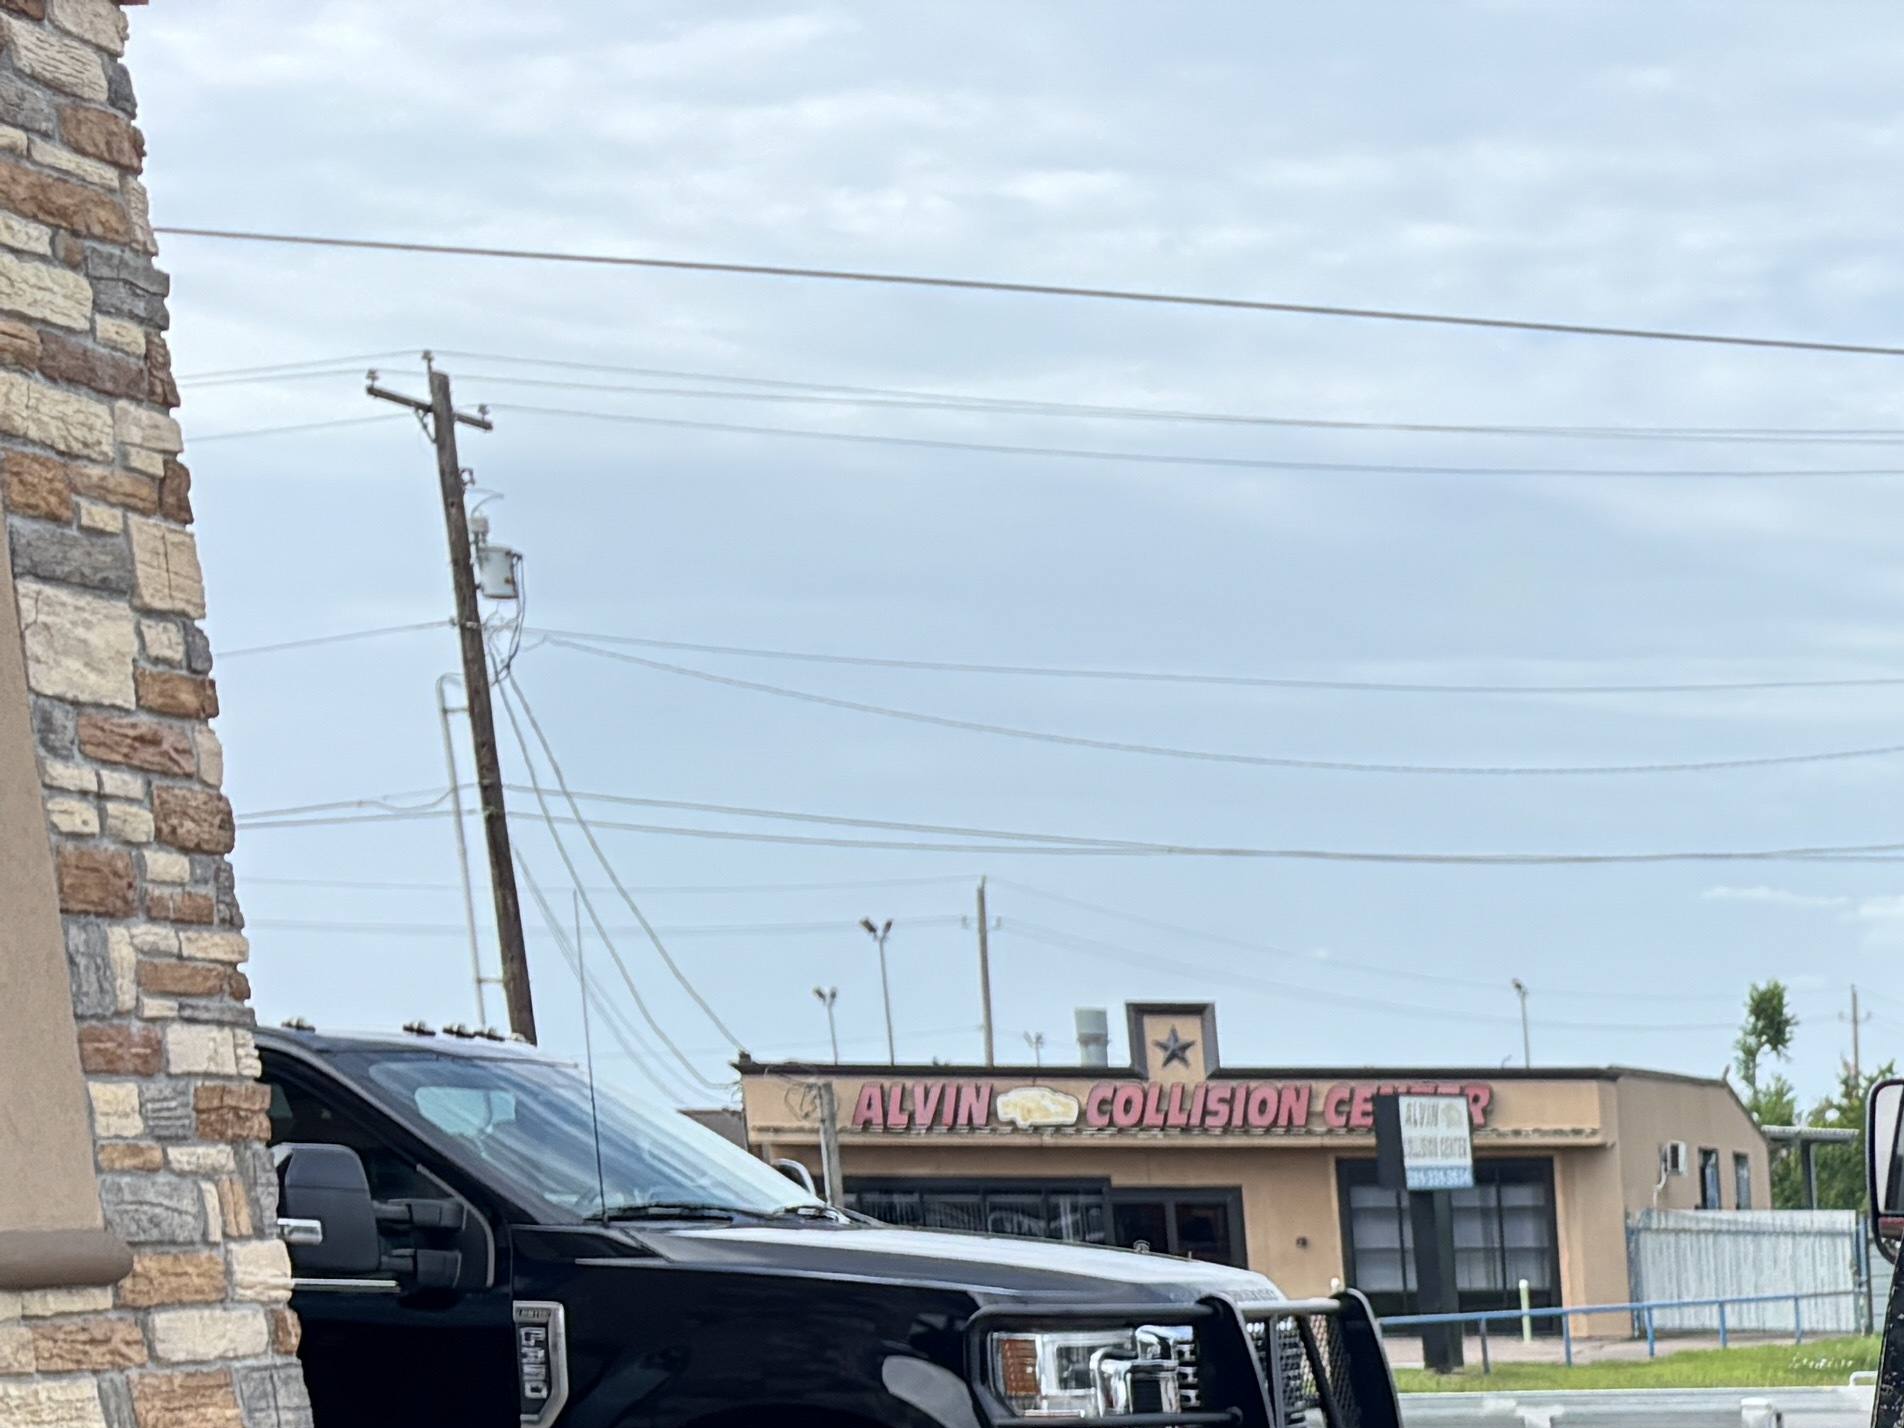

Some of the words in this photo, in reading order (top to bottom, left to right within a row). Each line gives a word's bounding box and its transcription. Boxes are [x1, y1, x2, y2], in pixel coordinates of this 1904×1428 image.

[852, 1081, 994, 1129] ALVIN
[1086, 1080, 1311, 1129] COLLISION
[1323, 1080, 1492, 1129] CER
